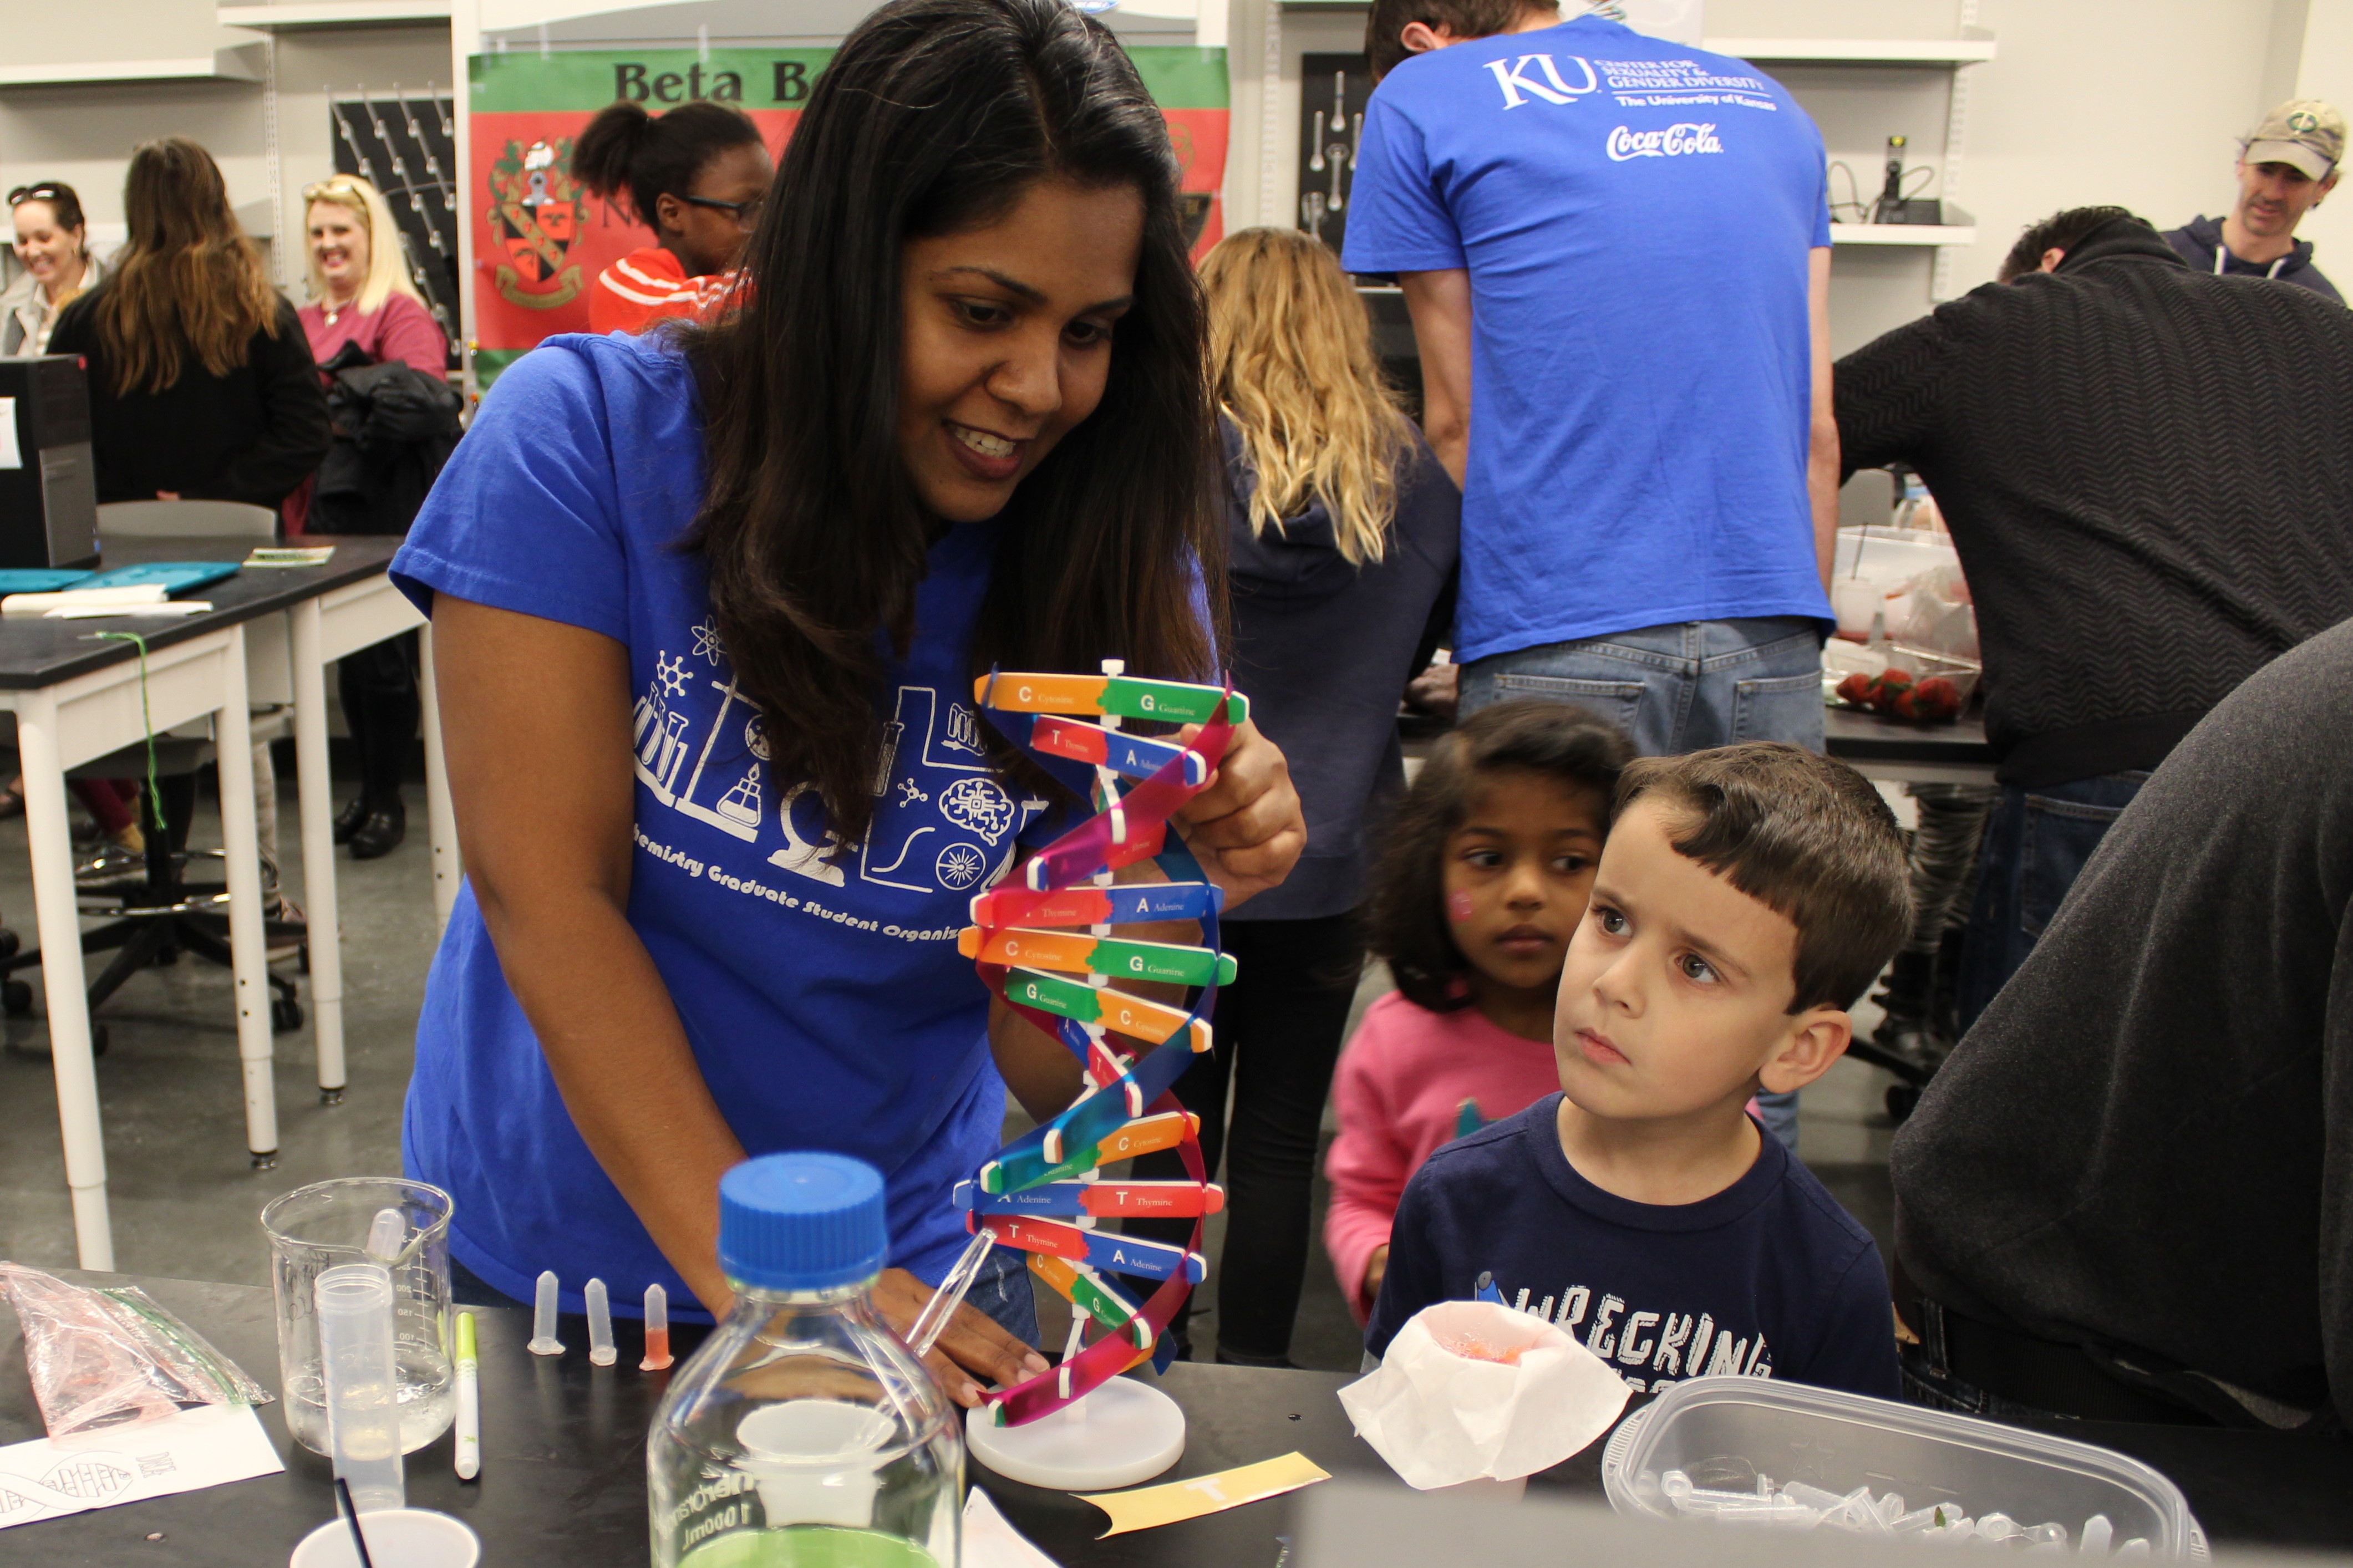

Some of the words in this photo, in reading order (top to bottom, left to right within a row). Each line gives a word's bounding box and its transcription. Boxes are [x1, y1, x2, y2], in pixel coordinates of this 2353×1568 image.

[614, 61, 743, 103] Beta
[772, 61, 823, 102] B
[1483, 53, 1598, 110] KU
[1607, 75, 1685, 89] GENDER
[1684, 77, 1765, 90] DIVERSITY
[1614, 96, 1646, 107] The
[1646, 94, 1719, 106] University
[1720, 94, 1733, 105] of
[1731, 95, 1777, 112] Kansas
[1018, 686, 1032, 702] C
[1140, 694, 1155, 711] G
[1158, 702, 1196, 716] Guanine
[1051, 729, 1061, 745] T
[1126, 749, 1137, 766] A
[633, 822, 704, 878] hemistry
[707, 864, 800, 909] Graduate
[802, 900, 879, 933] Student
[882, 925, 959, 943] Organiz
[1136, 897, 1150, 913] A
[1152, 902, 1185, 912] Adenine
[1005, 940, 1019, 956] C
[1024, 949, 1062, 961] Cytosine
[1129, 956, 1144, 972] G
[1147, 964, 1185, 978] Guanine
[1026, 983, 1038, 1000] G
[1039, 993, 1068, 1010] Guanine
[1120, 1009, 1132, 1026] C
[1118, 1137, 1130, 1151] C
[1133, 1137, 1162, 1148] Cytosine
[1044, 1163, 1074, 1177] uanine
[1016, 1194, 1052, 1204] Adenine
[1116, 1191, 1129, 1205] T
[1135, 1198, 1173, 1208] Thymine
[1009, 1224, 1020, 1239] T
[1026, 1234, 1059, 1249] Thymine
[1037, 1254, 1044, 1269] C
[1112, 1249, 1126, 1265] A
[1130, 1259, 1162, 1272] Adenine
[1092, 1297, 1101, 1314] G
